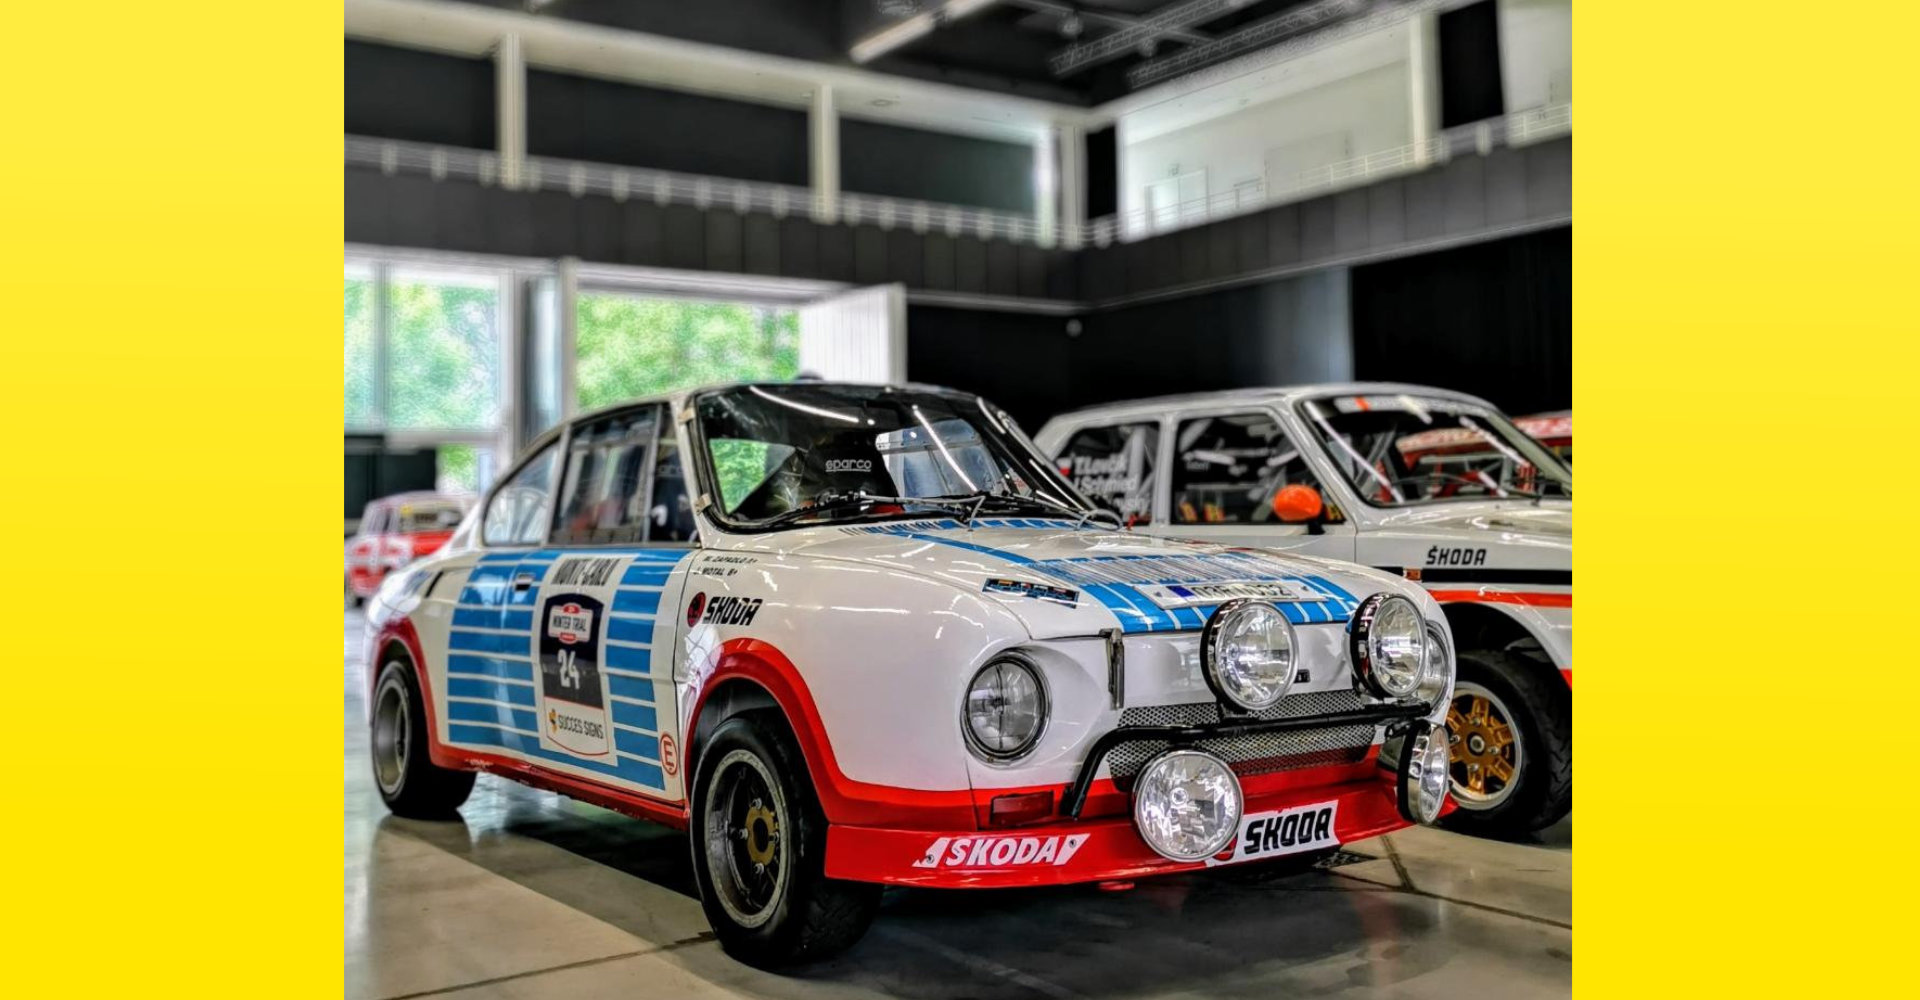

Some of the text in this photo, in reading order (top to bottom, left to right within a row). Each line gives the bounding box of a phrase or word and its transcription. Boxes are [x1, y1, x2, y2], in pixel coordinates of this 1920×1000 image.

[825, 459, 872, 470] sparco
[557, 649, 580, 690] 24
[558, 714, 604, 739] SUCCES SIGNS
